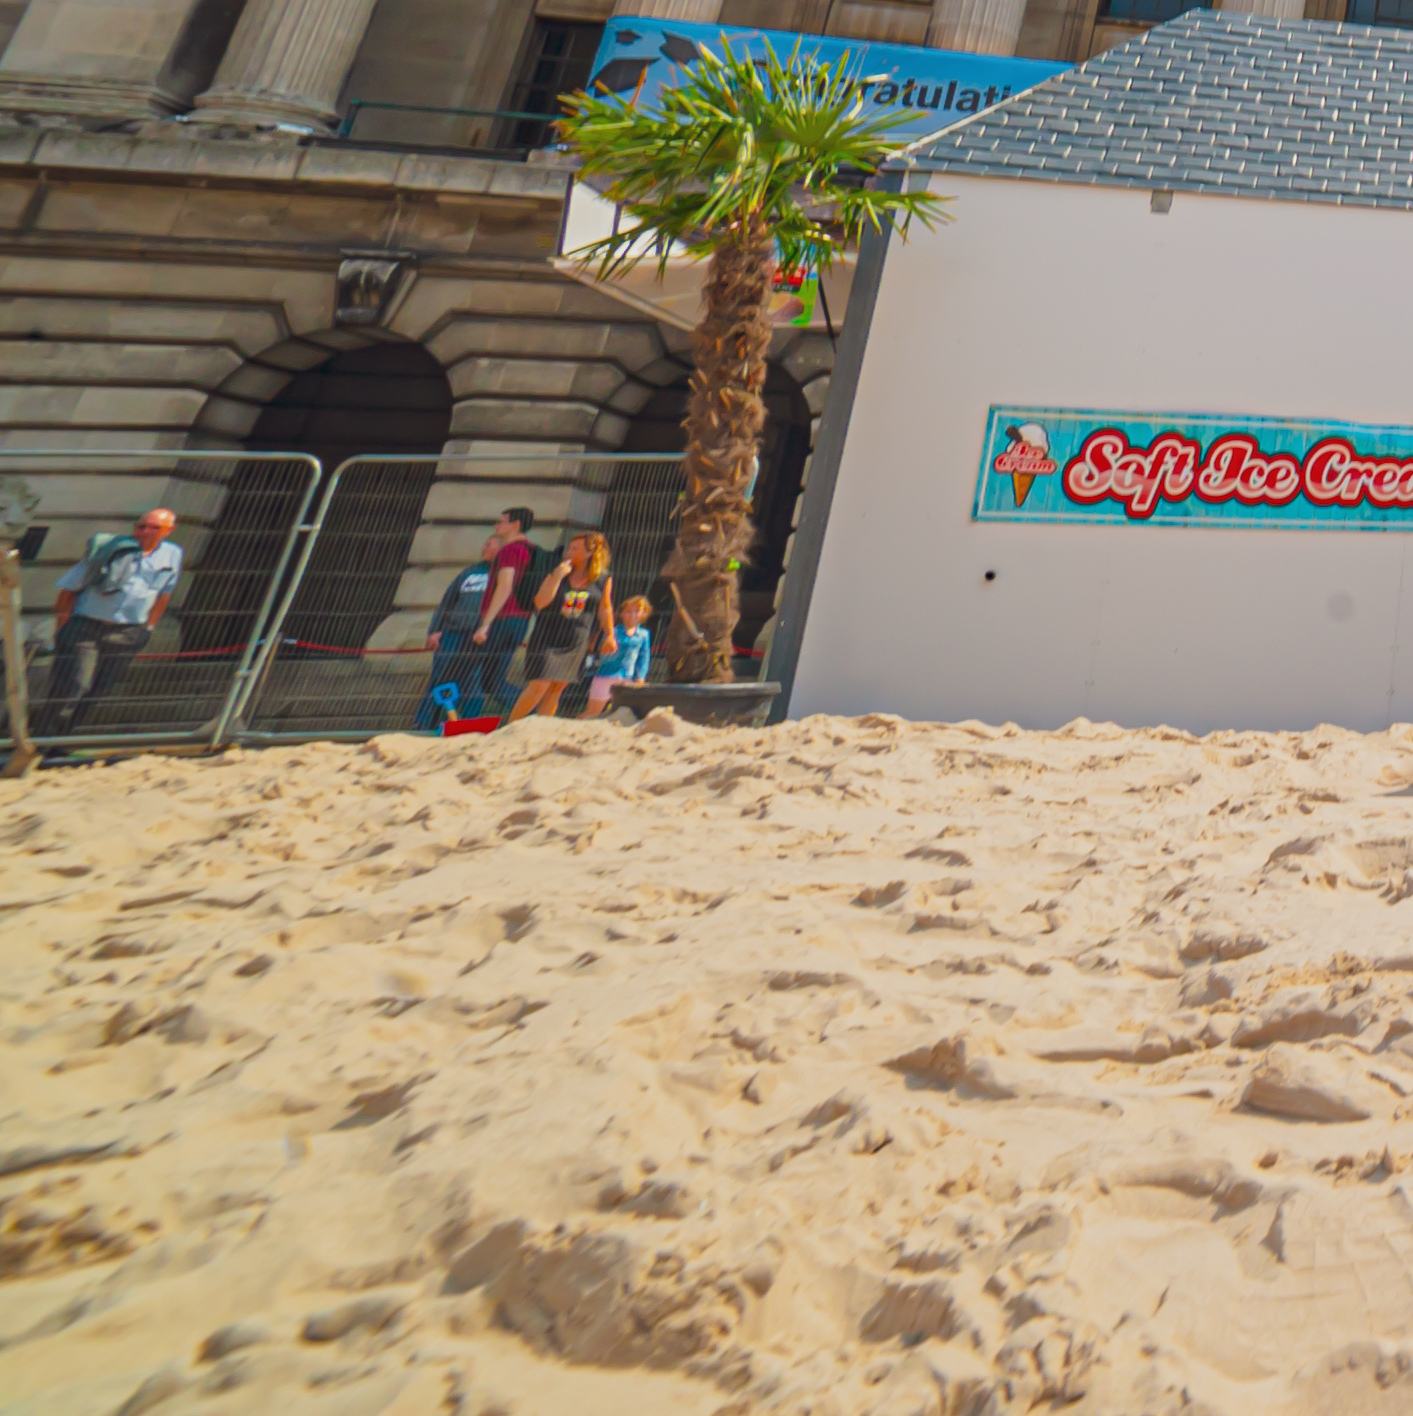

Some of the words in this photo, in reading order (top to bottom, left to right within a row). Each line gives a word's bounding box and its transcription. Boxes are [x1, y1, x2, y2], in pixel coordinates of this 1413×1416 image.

[994, 454, 1056, 474] Cream
[1066, 431, 1198, 515] Soft
[1196, 437, 1301, 502] Ice
